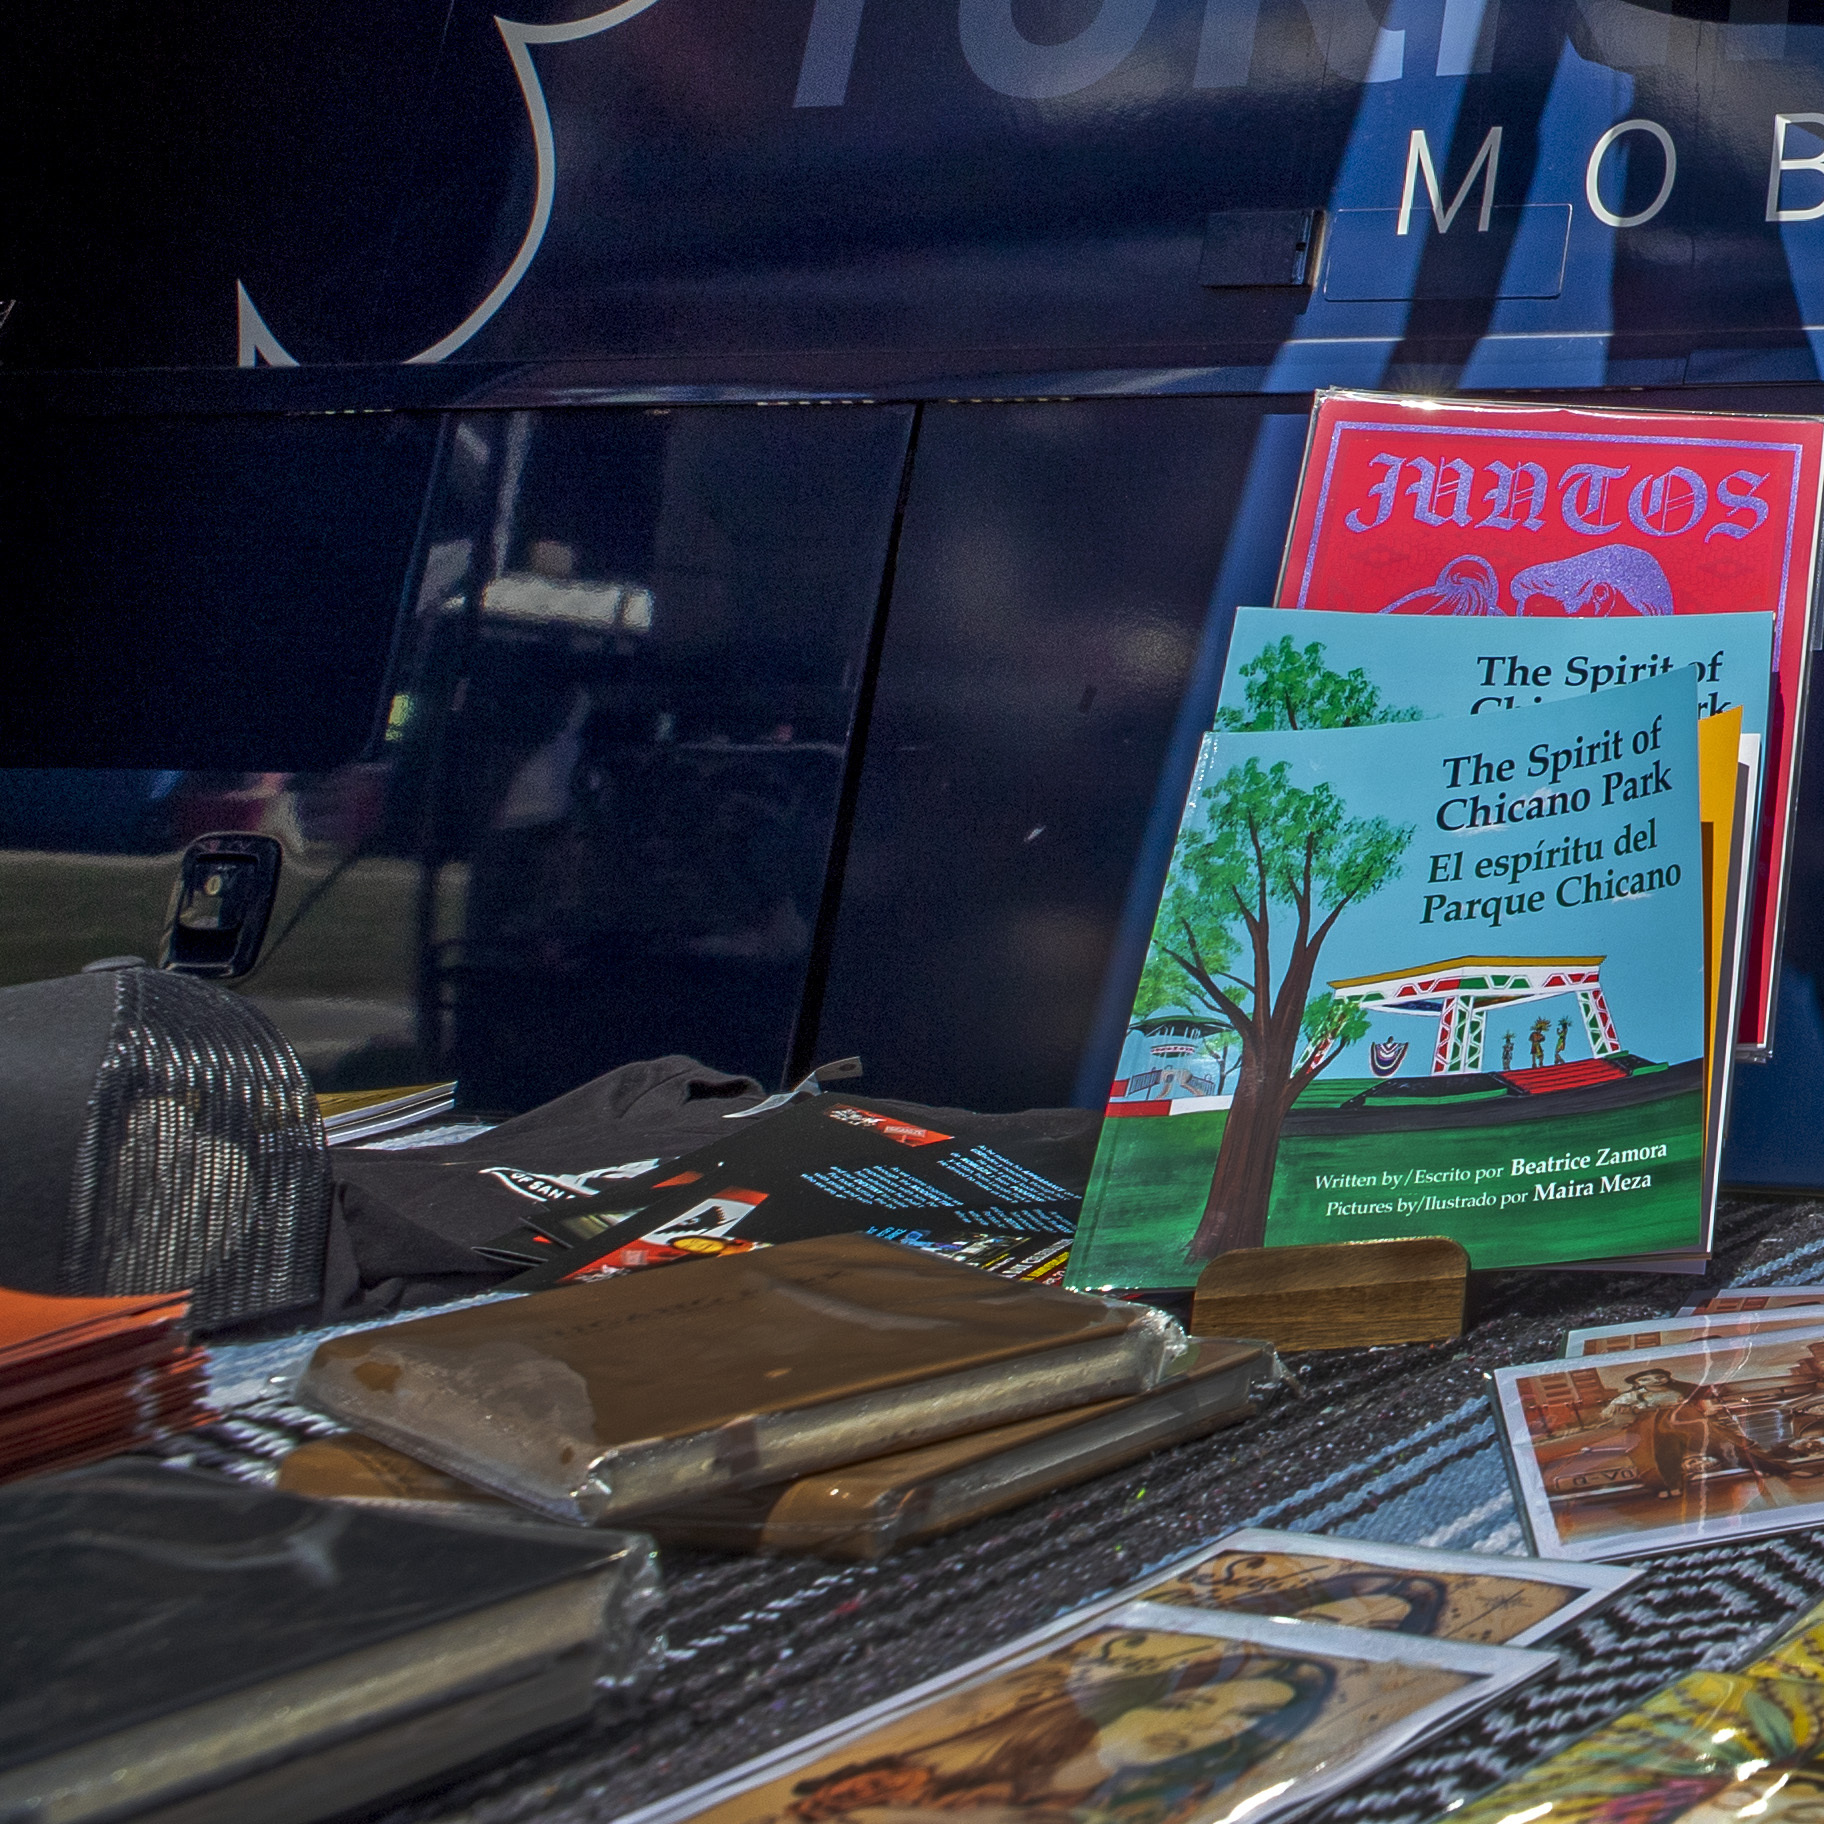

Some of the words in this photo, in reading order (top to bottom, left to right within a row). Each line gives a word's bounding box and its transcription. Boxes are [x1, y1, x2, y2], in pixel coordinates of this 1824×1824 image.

[1344, 450, 1771, 545] JUNTOS
[1475, 654, 1554, 688] The
[1563, 653, 1674, 691] Spirit
[1442, 751, 1516, 793] The
[1525, 725, 1622, 781] Spirit
[1630, 716, 1664, 760] of
[1435, 787, 1592, 834] Chicano
[1601, 759, 1674, 808] Park
[1426, 849, 1465, 886] El
[1473, 834, 1605, 889] espíritu
[1611, 819, 1658, 857] del
[1419, 885, 1546, 930] Parque
[1554, 857, 1683, 908] Chicano
[1314, 1170, 1377, 1190] Written
[1475, 1167, 1503, 1184] por
[1510, 1154, 1591, 1178] Beatrice
[1597, 1143, 1668, 1168] Zamora
[1325, 1199, 1393, 1217] Pictures
[1500, 1190, 1528, 1210] por
[1532, 1183, 1594, 1203] Maira
[1599, 1174, 1652, 1195] Meza
